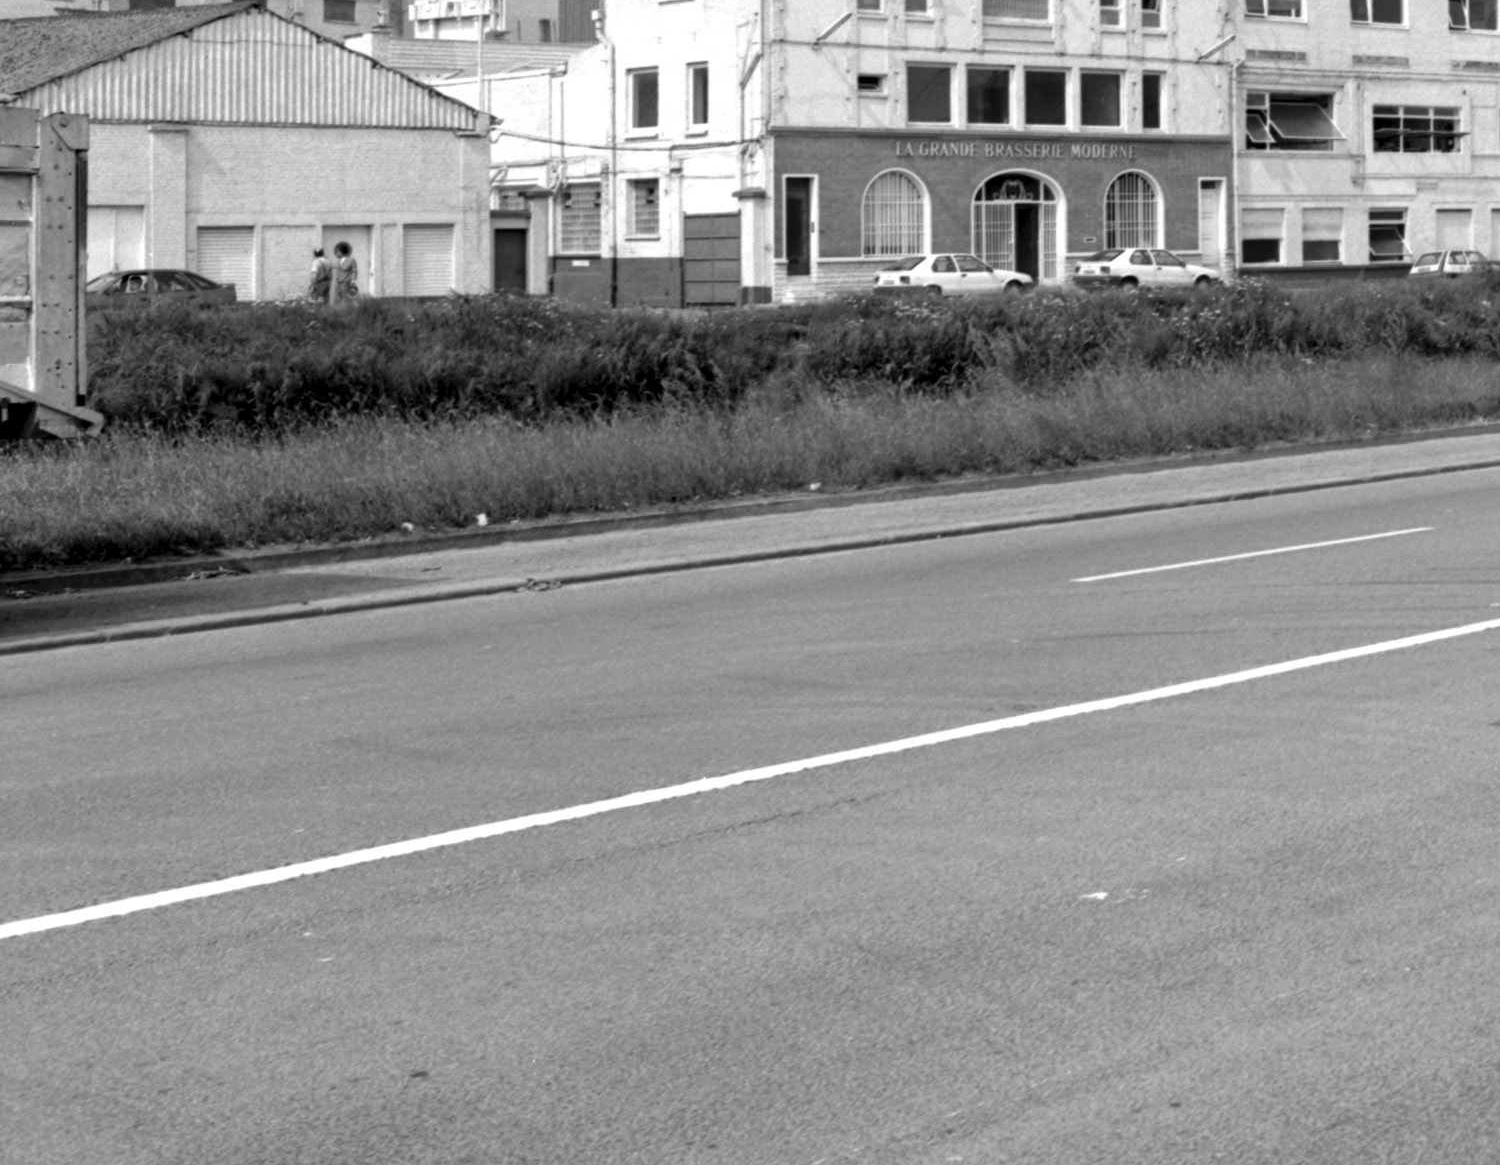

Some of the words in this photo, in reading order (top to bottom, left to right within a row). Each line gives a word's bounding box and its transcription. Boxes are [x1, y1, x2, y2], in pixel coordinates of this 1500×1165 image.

[896, 140, 914, 156] LA
[919, 141, 979, 157] GRANDE
[985, 142, 1063, 158] BRASSERIE
[1071, 143, 1136, 159] MODERNE
